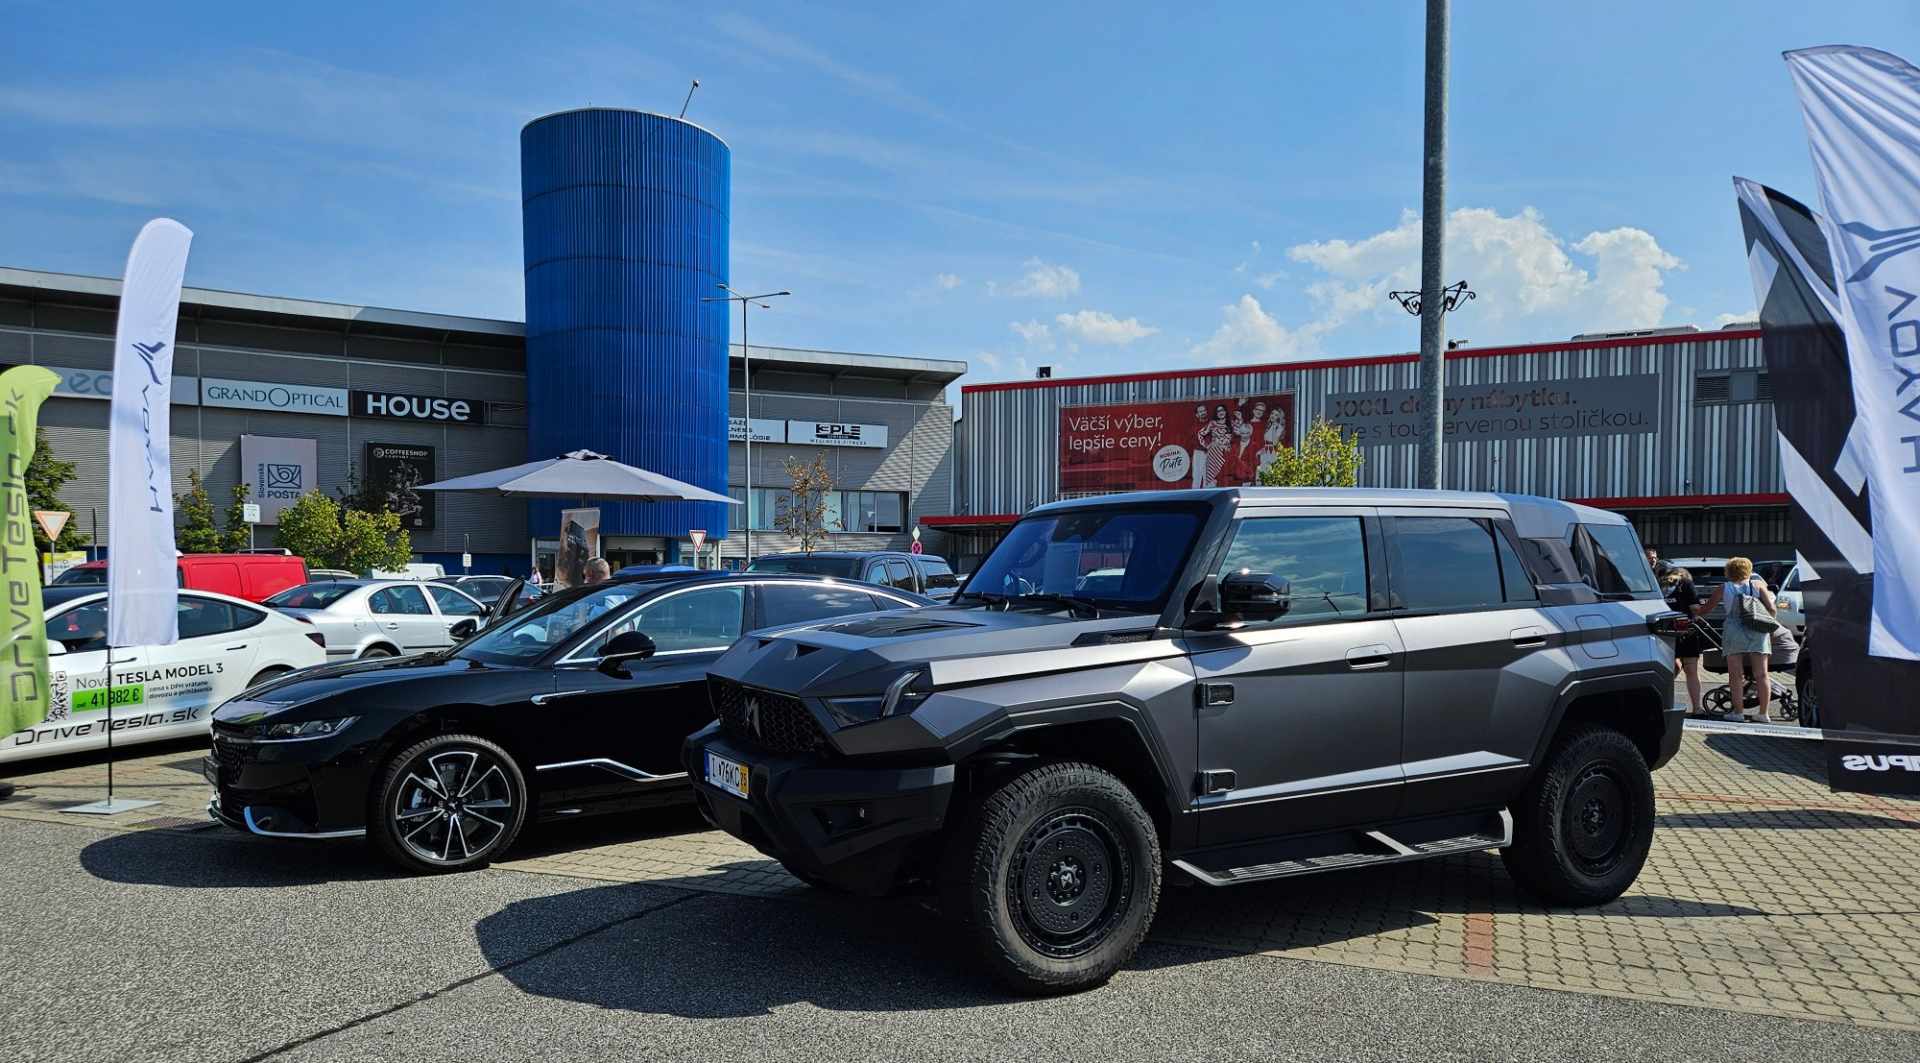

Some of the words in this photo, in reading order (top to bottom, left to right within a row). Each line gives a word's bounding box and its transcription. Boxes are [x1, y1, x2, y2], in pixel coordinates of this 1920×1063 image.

[1069, 415, 1110, 432] Väčší
[1113, 414, 1164, 433] výber,
[1443, 412, 1533, 436] ervenou
[1538, 408, 1649, 430] stoličkou.
[1069, 435, 1115, 452] lepšie
[1119, 432, 1163, 450] ceny!
[2, 387, 38, 702] DriveTeslask
[116, 669, 162, 685] TESLA
[165, 664, 213, 680] MODEL
[216, 663, 223, 673] 3
